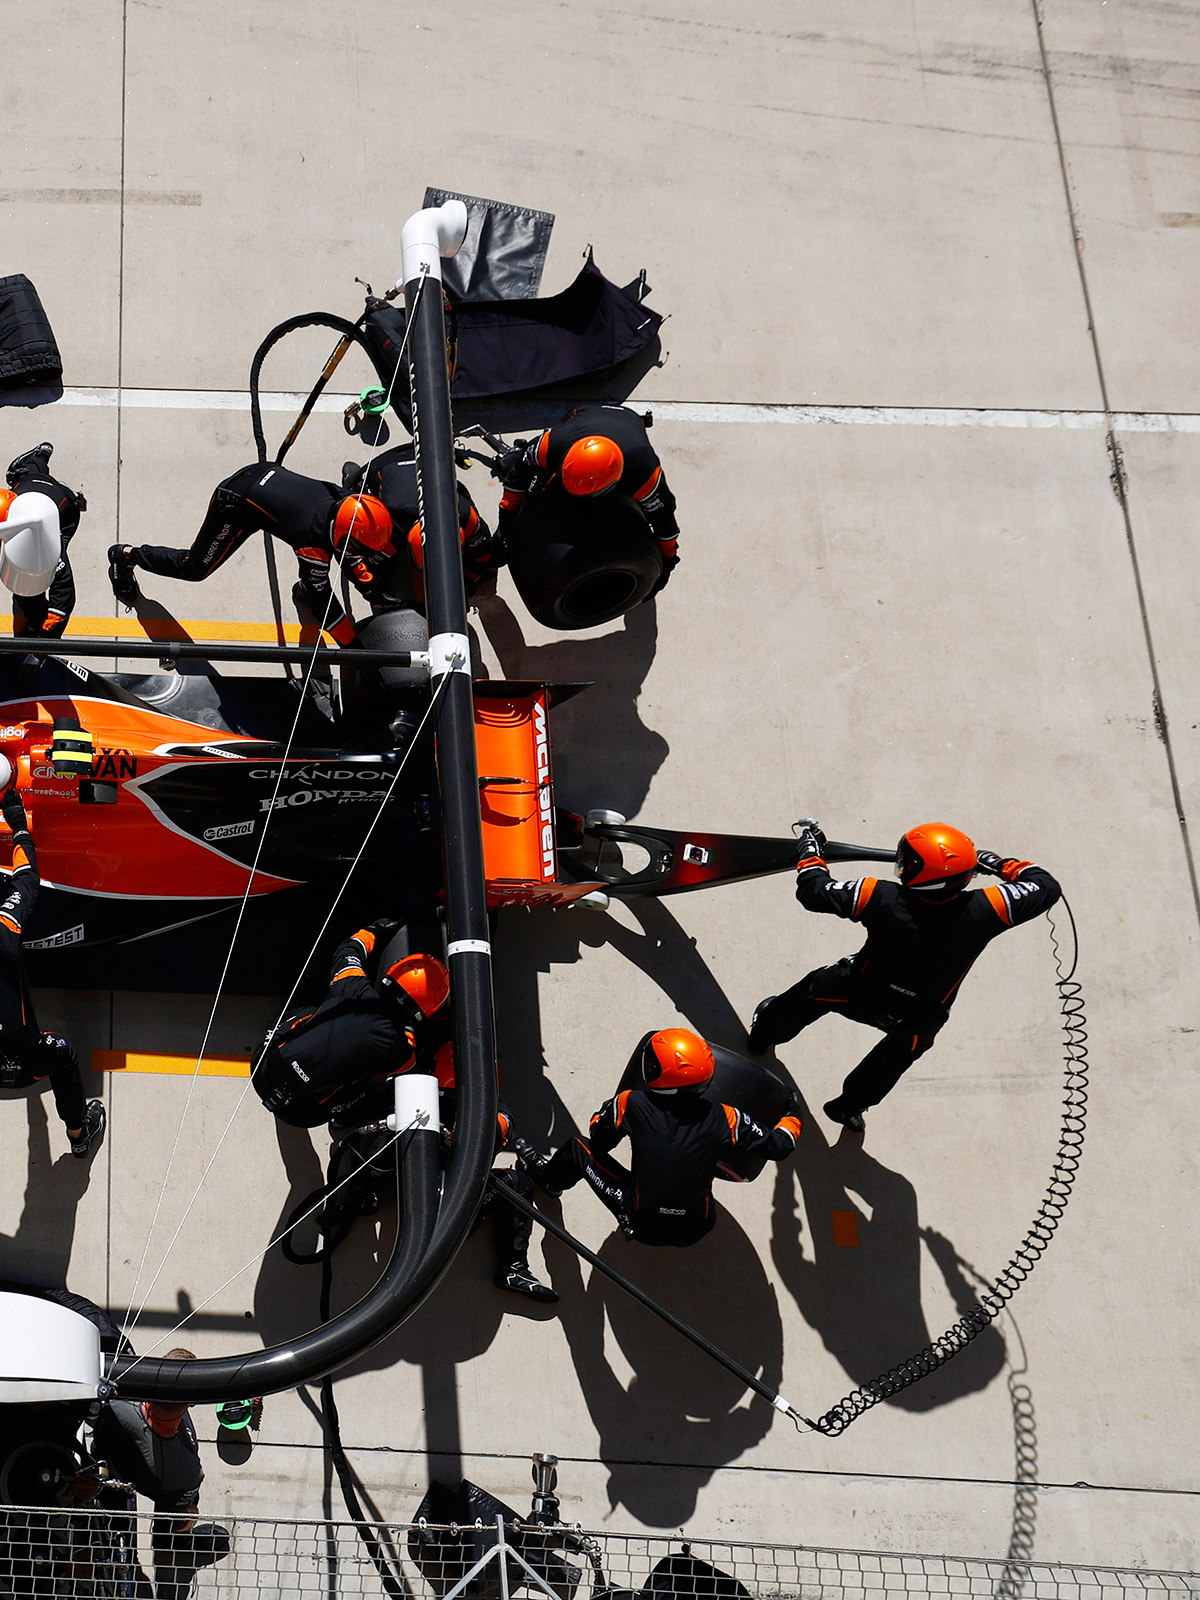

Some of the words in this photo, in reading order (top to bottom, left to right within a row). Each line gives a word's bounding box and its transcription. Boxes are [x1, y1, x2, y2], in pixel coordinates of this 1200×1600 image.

[248, 769, 400, 781] CHANDON
[20, 788, 53, 797] MICHAEL
[533, 702, 556, 878] McLaren
[259, 789, 396, 812] HONDA
[216, 822, 253, 839] Castrol
[291, 1060, 310, 1083] sparco
